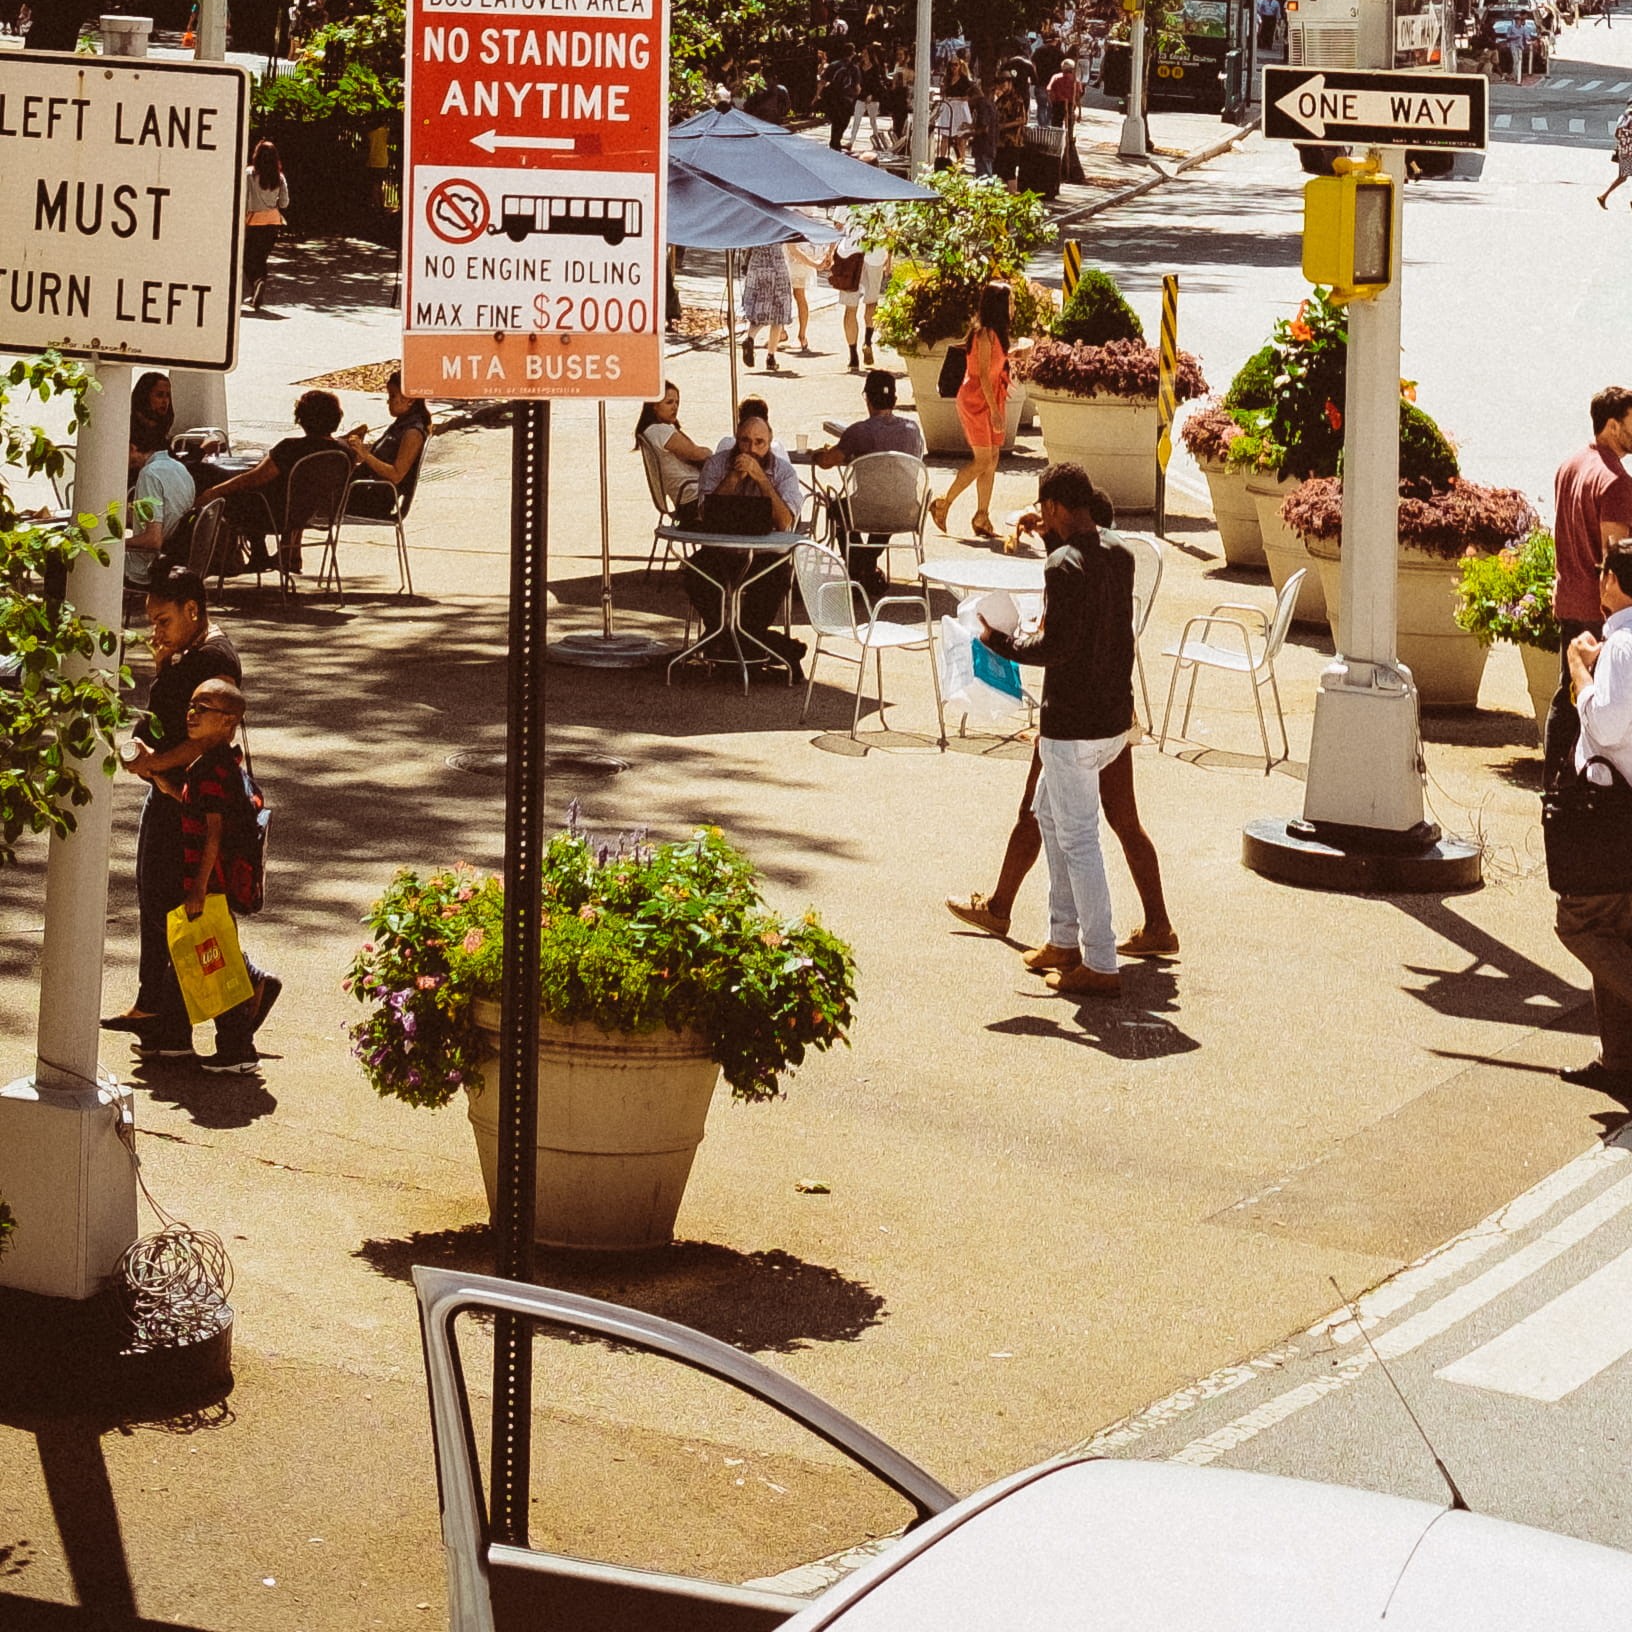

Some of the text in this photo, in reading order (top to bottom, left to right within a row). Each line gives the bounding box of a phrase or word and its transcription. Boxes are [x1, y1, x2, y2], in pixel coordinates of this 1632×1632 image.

[423, 26, 650, 70] NO STANDING
[0, 93, 218, 151] LEFT LANE
[440, 79, 630, 122] ANYTIME
[1298, 92, 1455, 125] ONE WAY
[35, 178, 171, 241] MUST
[425, 255, 641, 286] NO ENGINE IDLING
[115, 278, 212, 328] LEFT
[416, 292, 648, 334] MAX FINE $2000
[441, 354, 622, 381] MTA BUSES
